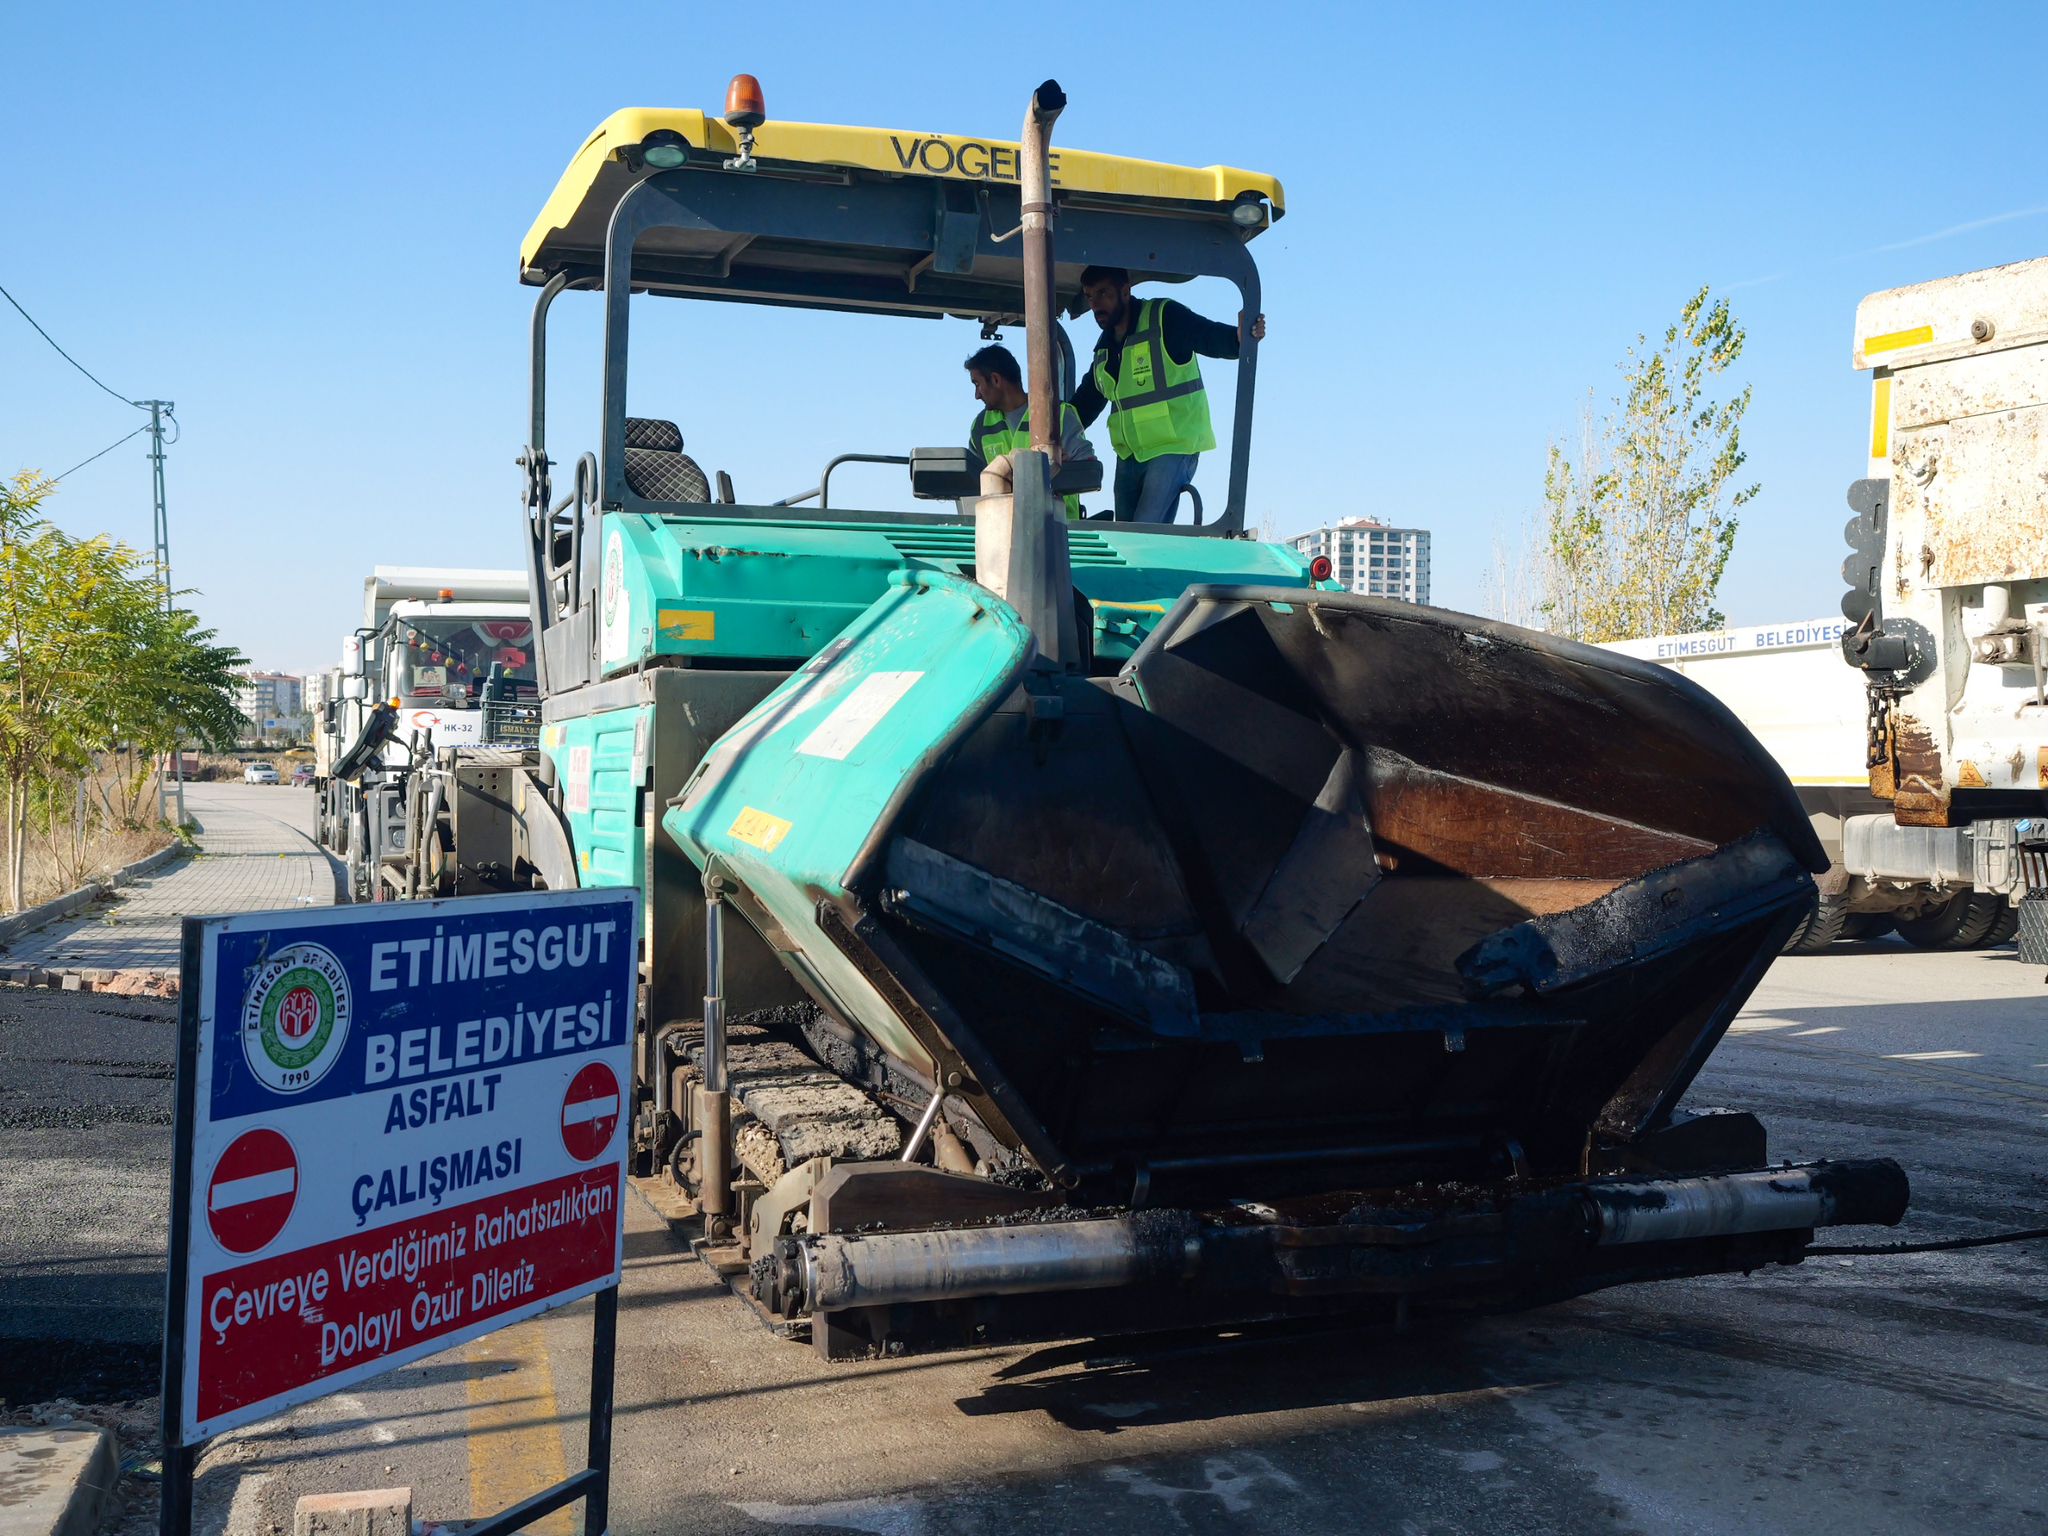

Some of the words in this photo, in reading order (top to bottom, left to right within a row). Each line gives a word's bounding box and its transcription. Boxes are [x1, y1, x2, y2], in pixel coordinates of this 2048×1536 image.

[1657, 637, 1736, 657] ETİMESGUT
[444, 723, 473, 732] HK-32
[369, 920, 617, 992] ETİMESGUT
[364, 989, 612, 1085] BELEDİYESİ
[281, 1069, 310, 1086] 1990
[383, 1073, 502, 1135] ASFALT
[351, 1137, 522, 1227] ÇALIŞMASI
[209, 1267, 330, 1345] Çevreye
[338, 1220, 467, 1293] Verdiğimiz
[474, 1183, 613, 1252] Rahatsızlıktan
[320, 1307, 402, 1367] Dolayı
[410, 1280, 465, 1332] Özür
[471, 1257, 535, 1312] Dileriz
